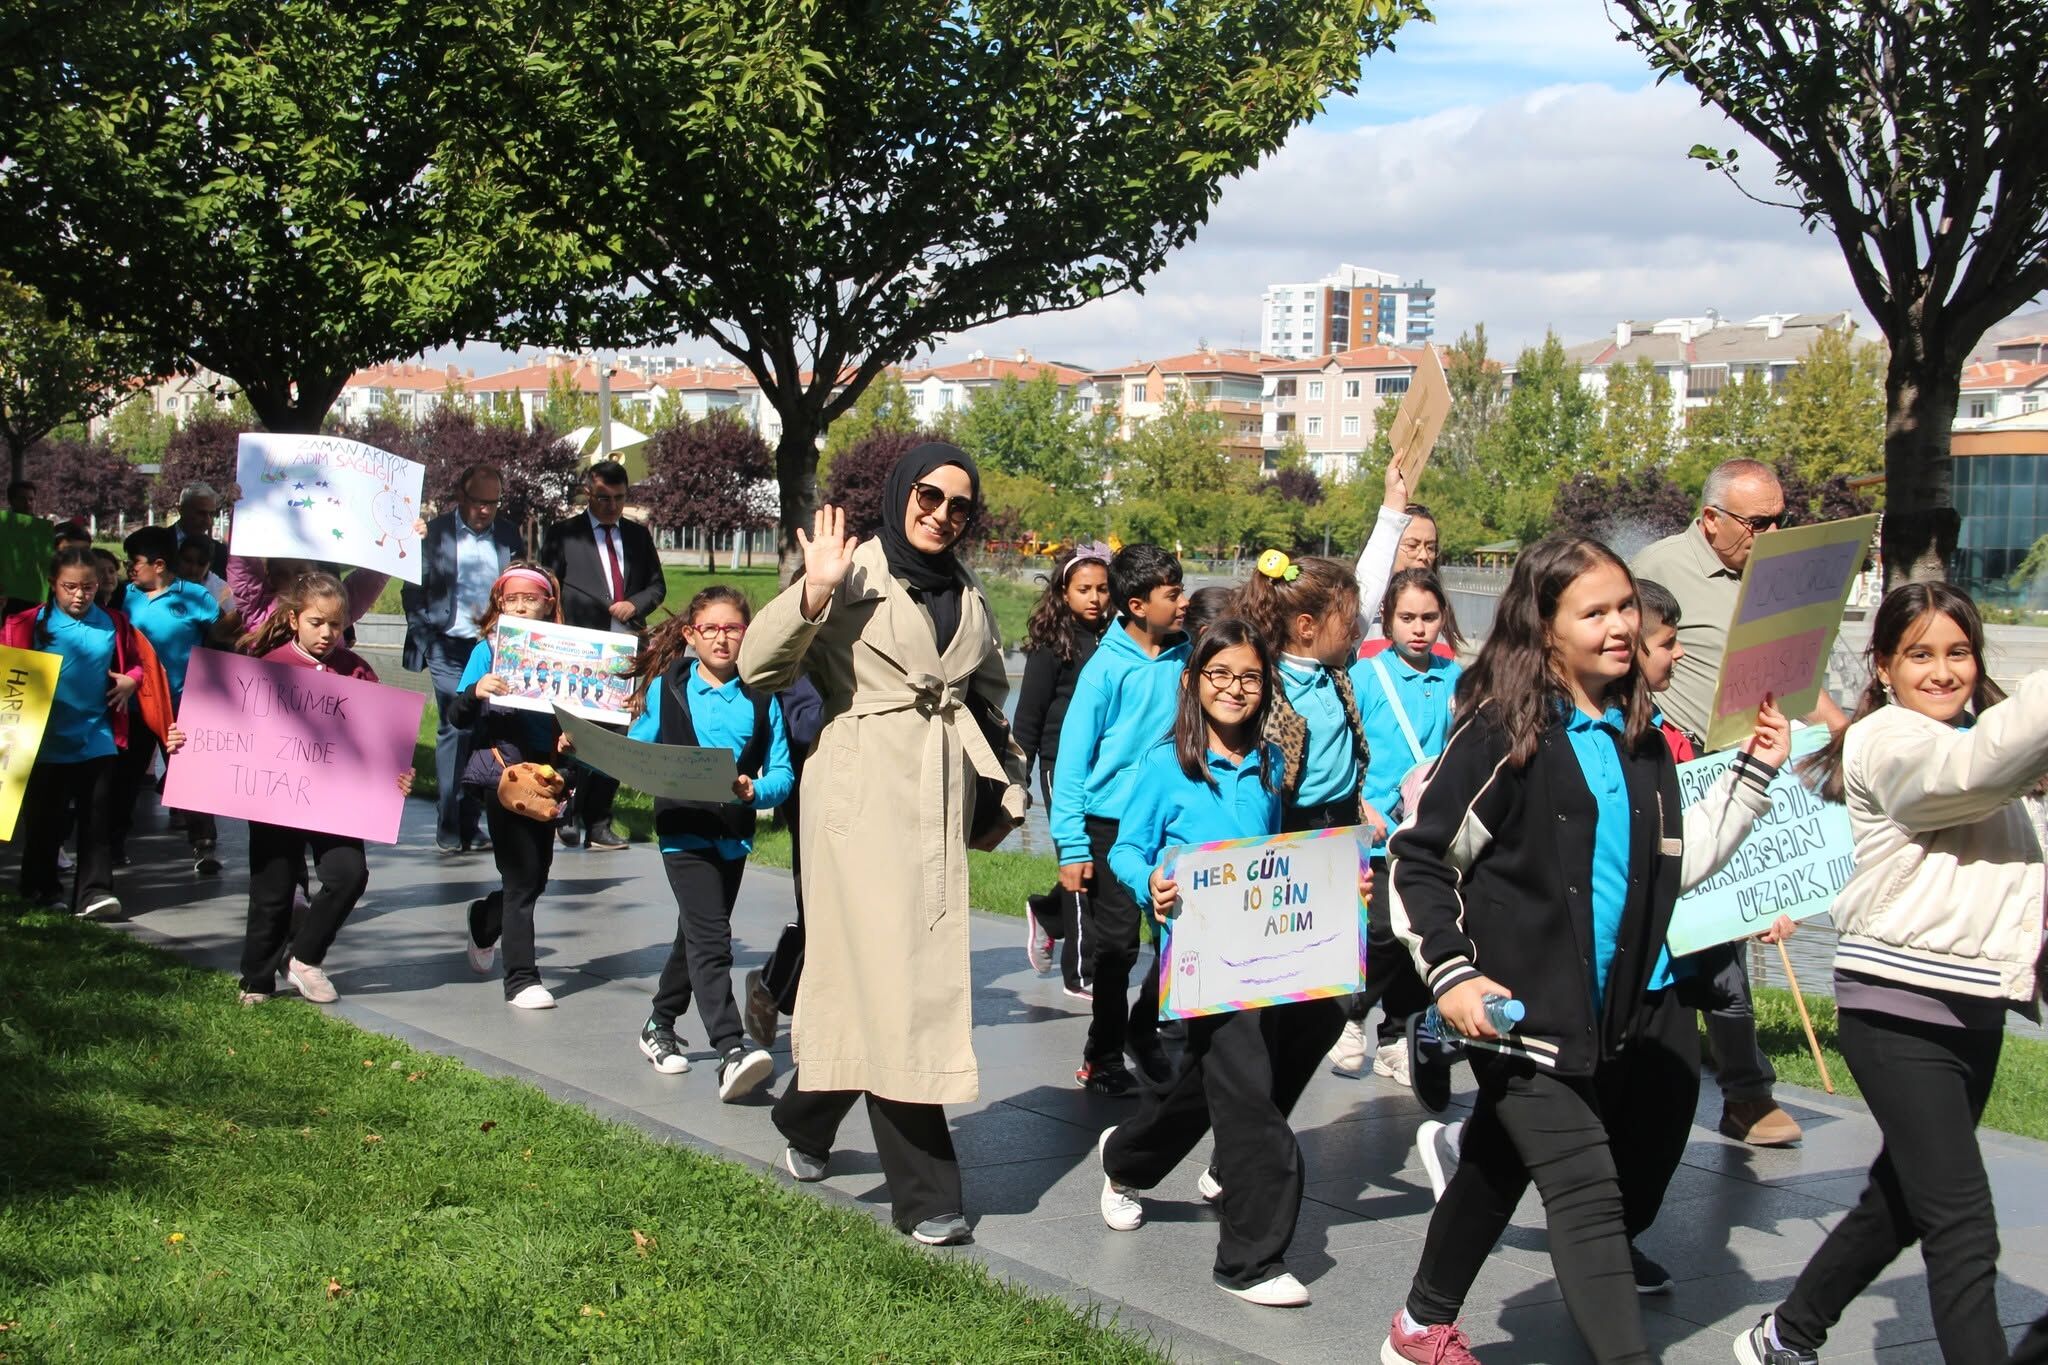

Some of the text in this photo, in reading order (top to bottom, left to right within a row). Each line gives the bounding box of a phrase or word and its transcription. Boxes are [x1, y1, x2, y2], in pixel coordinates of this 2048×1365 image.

[293, 452, 329, 466] ADIM
[297, 440, 409, 478] ZAMAN AKIYOR
[237, 676, 349, 719] YÜRÜMEK
[276, 736, 336, 763] ZİNDE
[230, 764, 311, 806] TUTAR
[1193, 850, 1290, 890] HER GÜN
[1272, 878, 1308, 907] BİN
[1736, 862, 1829, 923] UZAK
[1264, 911, 1313, 937] ADIM
